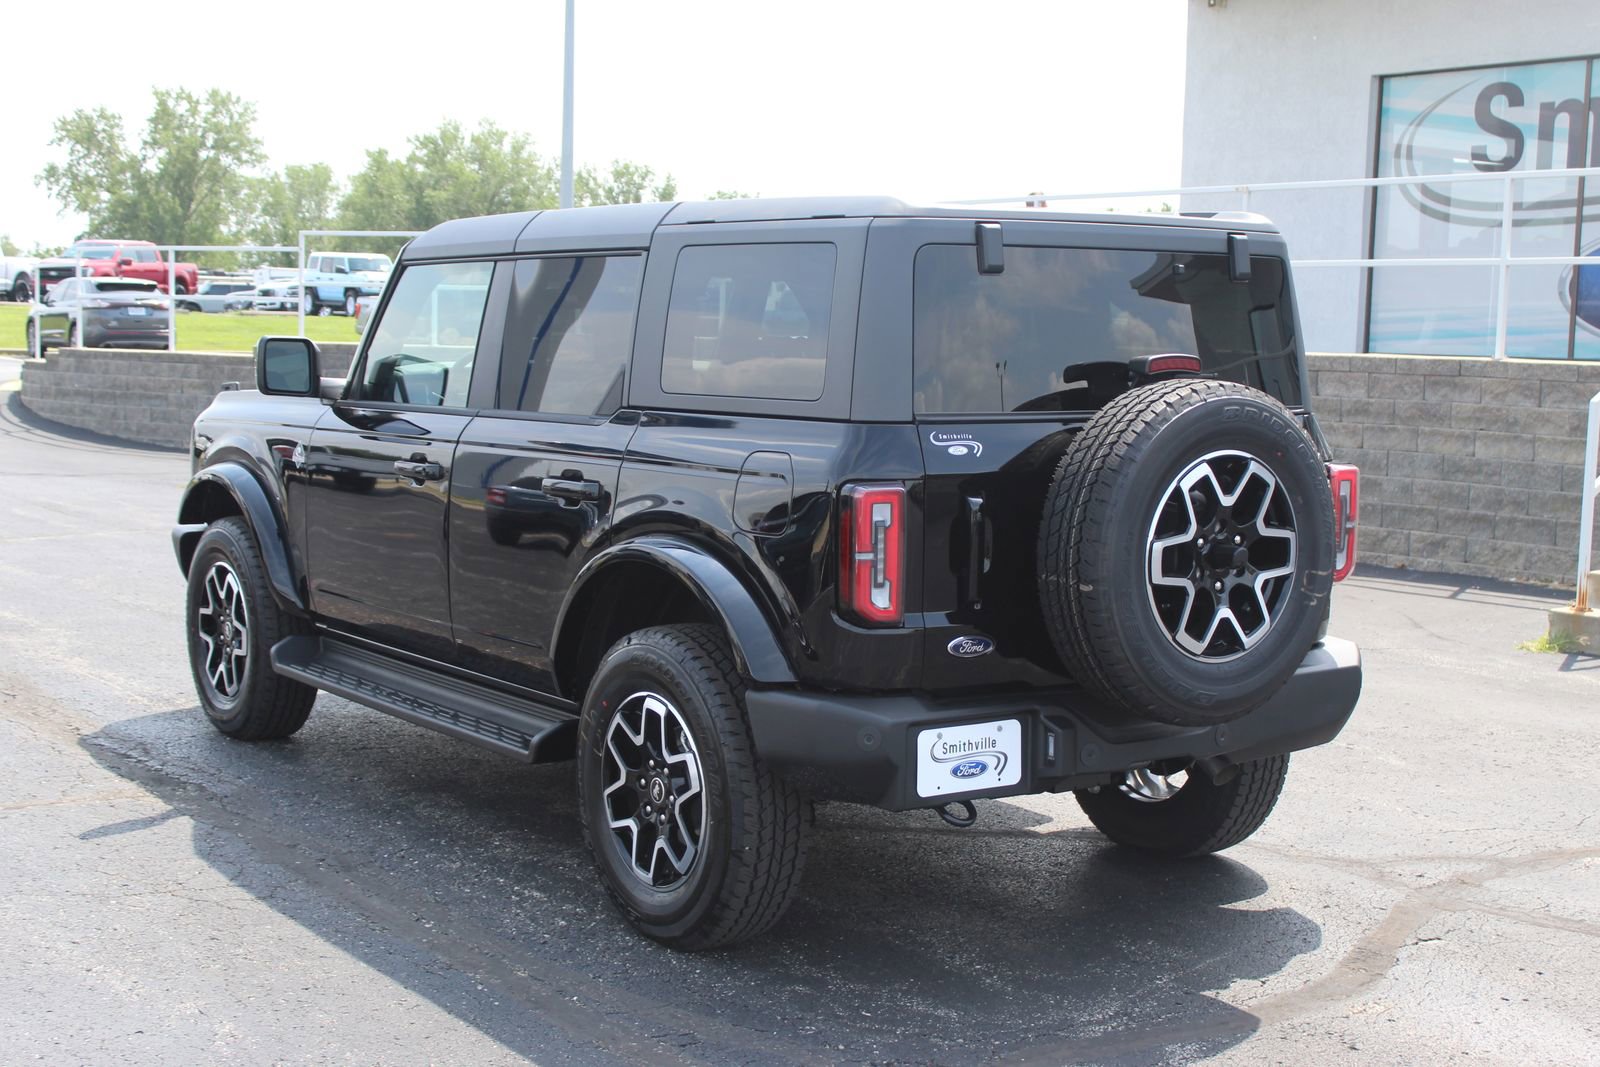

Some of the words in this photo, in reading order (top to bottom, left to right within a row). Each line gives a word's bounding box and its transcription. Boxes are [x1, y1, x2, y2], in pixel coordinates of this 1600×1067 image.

[959, 640, 985, 653] Ford
[942, 736, 997, 755] Smithville
[957, 762, 983, 777] Ford
